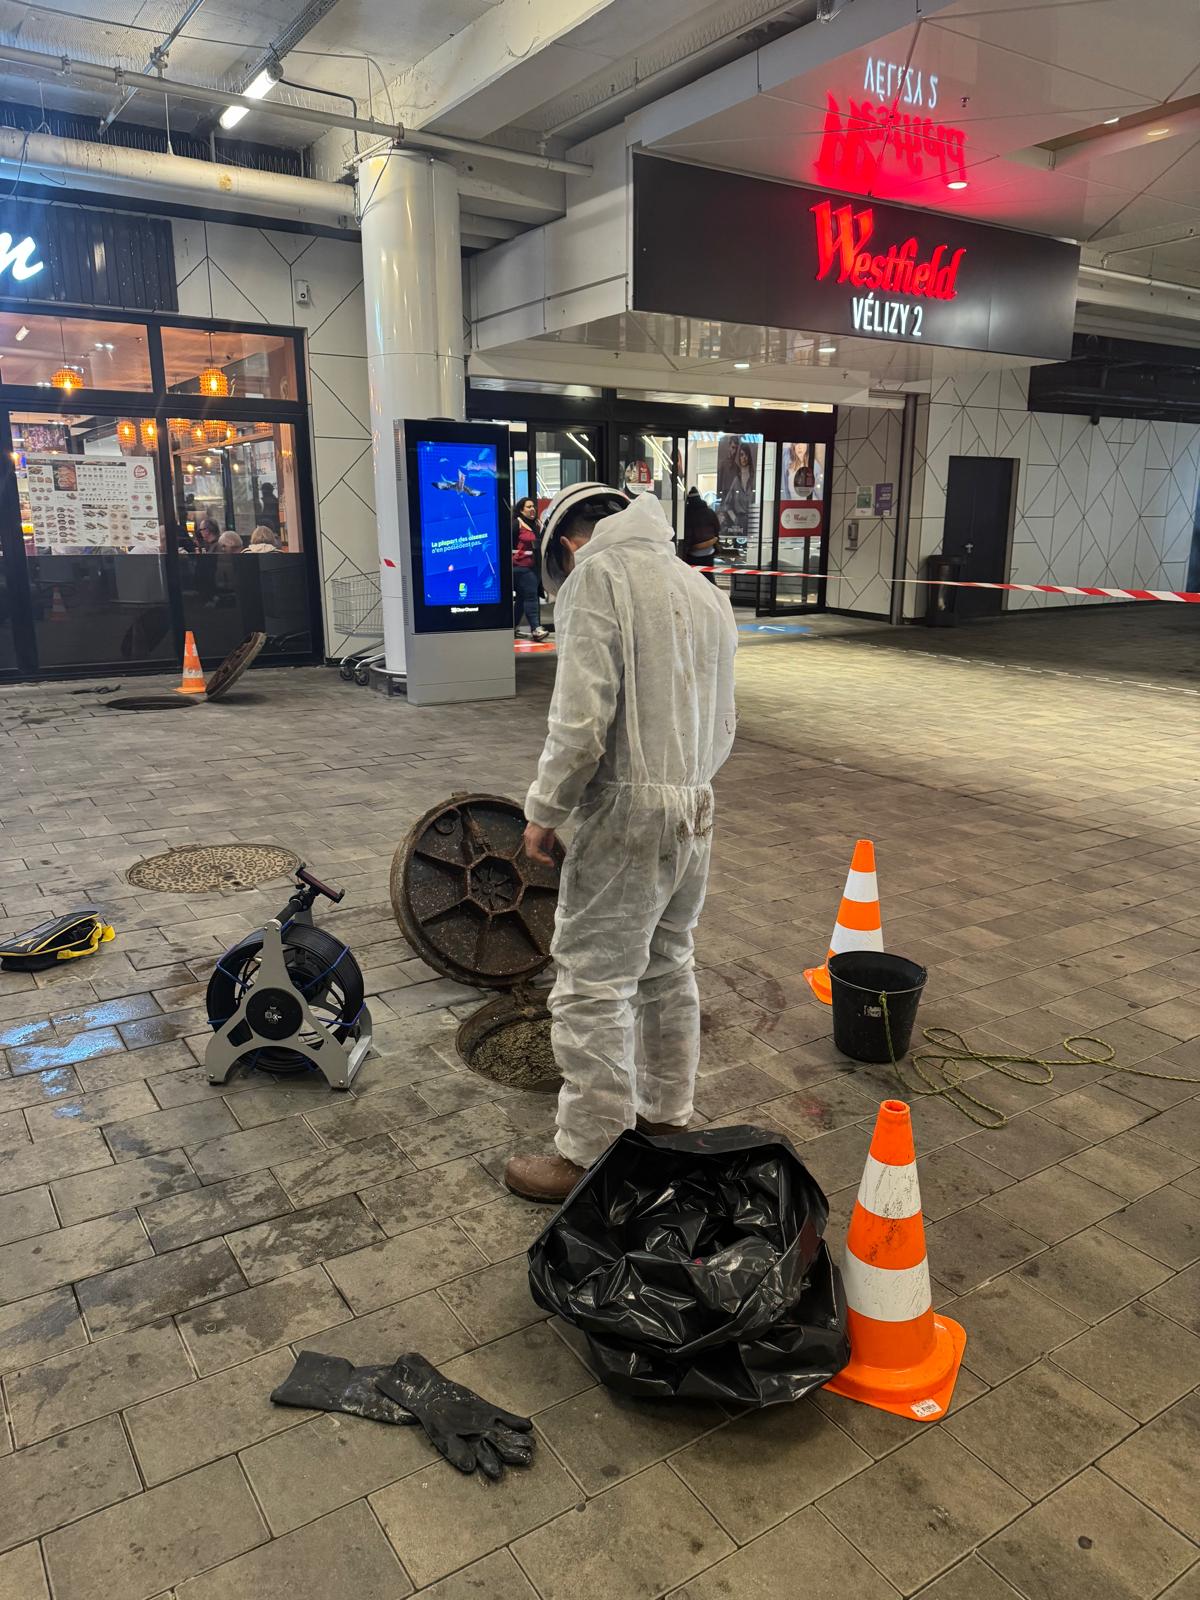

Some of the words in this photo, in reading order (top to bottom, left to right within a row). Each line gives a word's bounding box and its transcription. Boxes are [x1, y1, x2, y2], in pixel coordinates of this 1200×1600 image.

[809, 200, 966, 300] Westfield
[852, 291, 910, 335] VÉLIZY
[912, 305, 923, 336] 2
